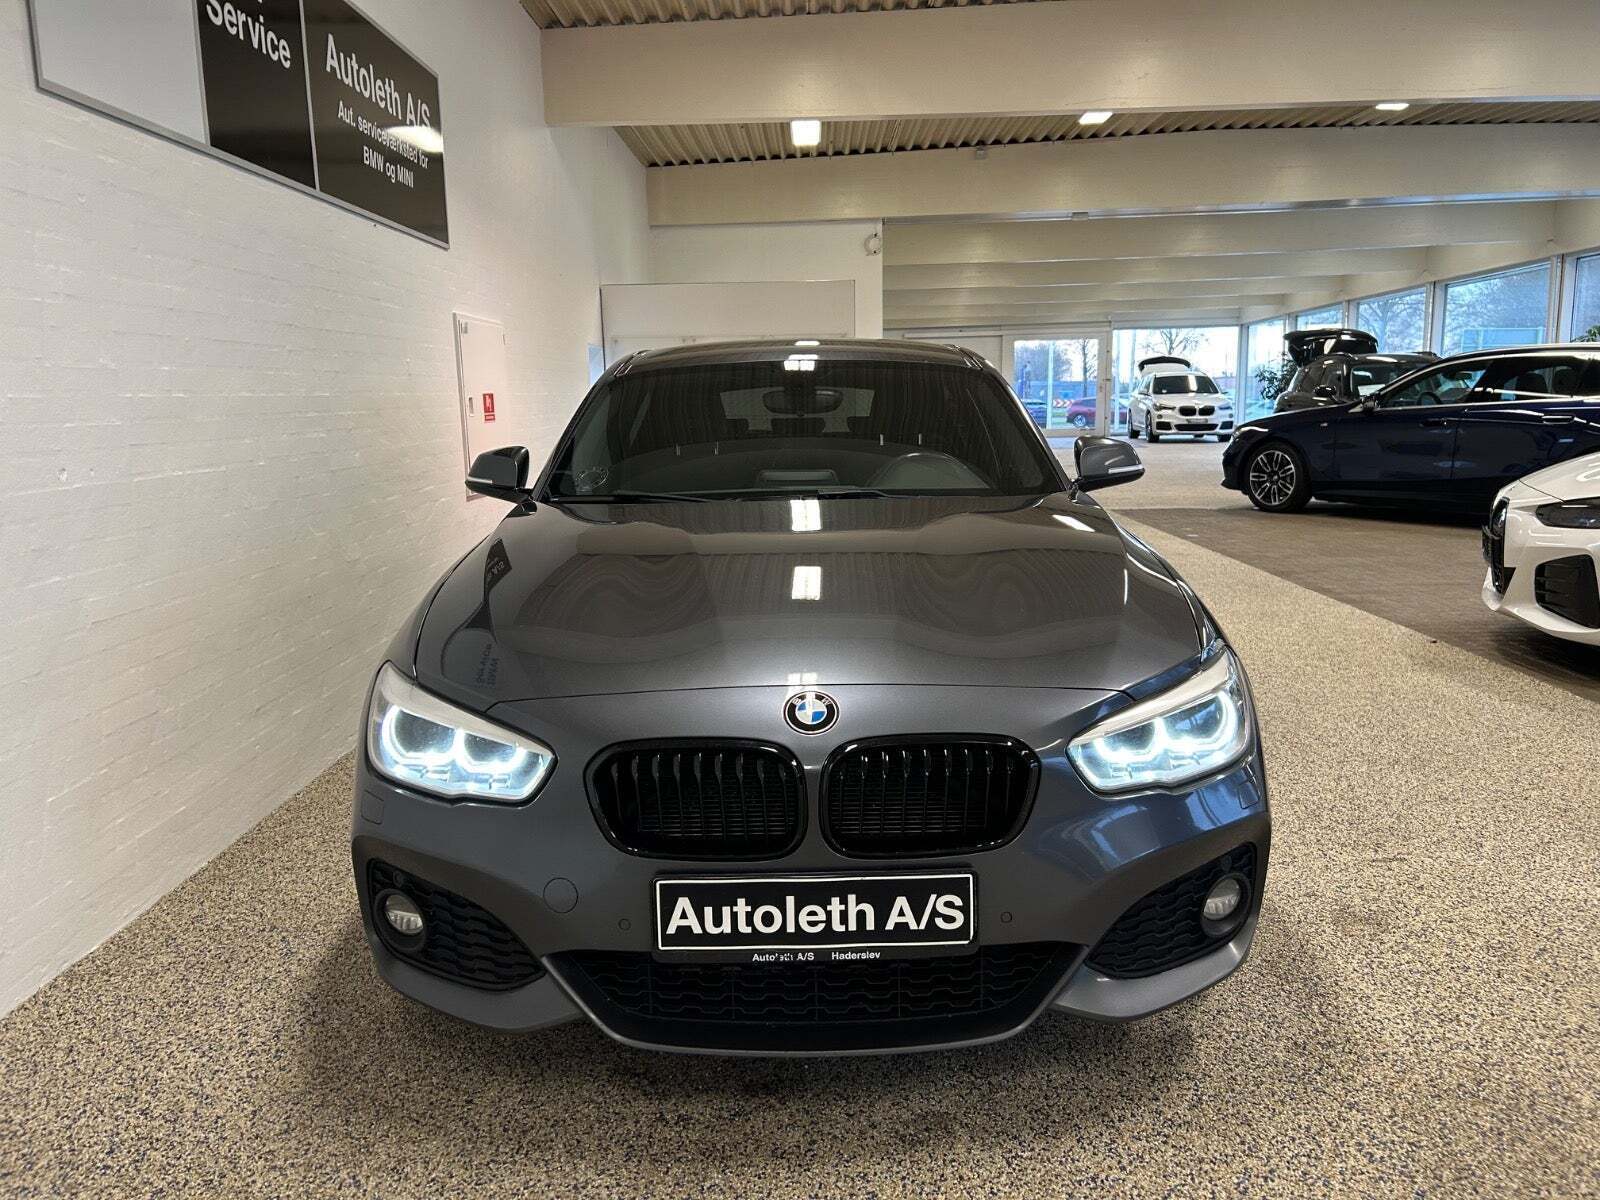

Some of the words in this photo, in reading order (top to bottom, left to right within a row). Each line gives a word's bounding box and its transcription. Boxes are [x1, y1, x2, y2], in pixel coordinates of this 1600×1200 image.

[206, 0, 291, 69] Service
[326, 32, 401, 120] Autoleth
[406, 92, 430, 128] A/S
[337, 100, 356, 127] Aut.
[419, 148, 429, 169] for
[363, 145, 384, 173] BMW
[386, 162, 396, 184] og
[397, 163, 414, 189] MINI
[666, 893, 875, 935] Autoleth
[885, 894, 965, 931] A/S
[796, 952, 815, 961] A/S
[831, 950, 881, 961] Haderslev
